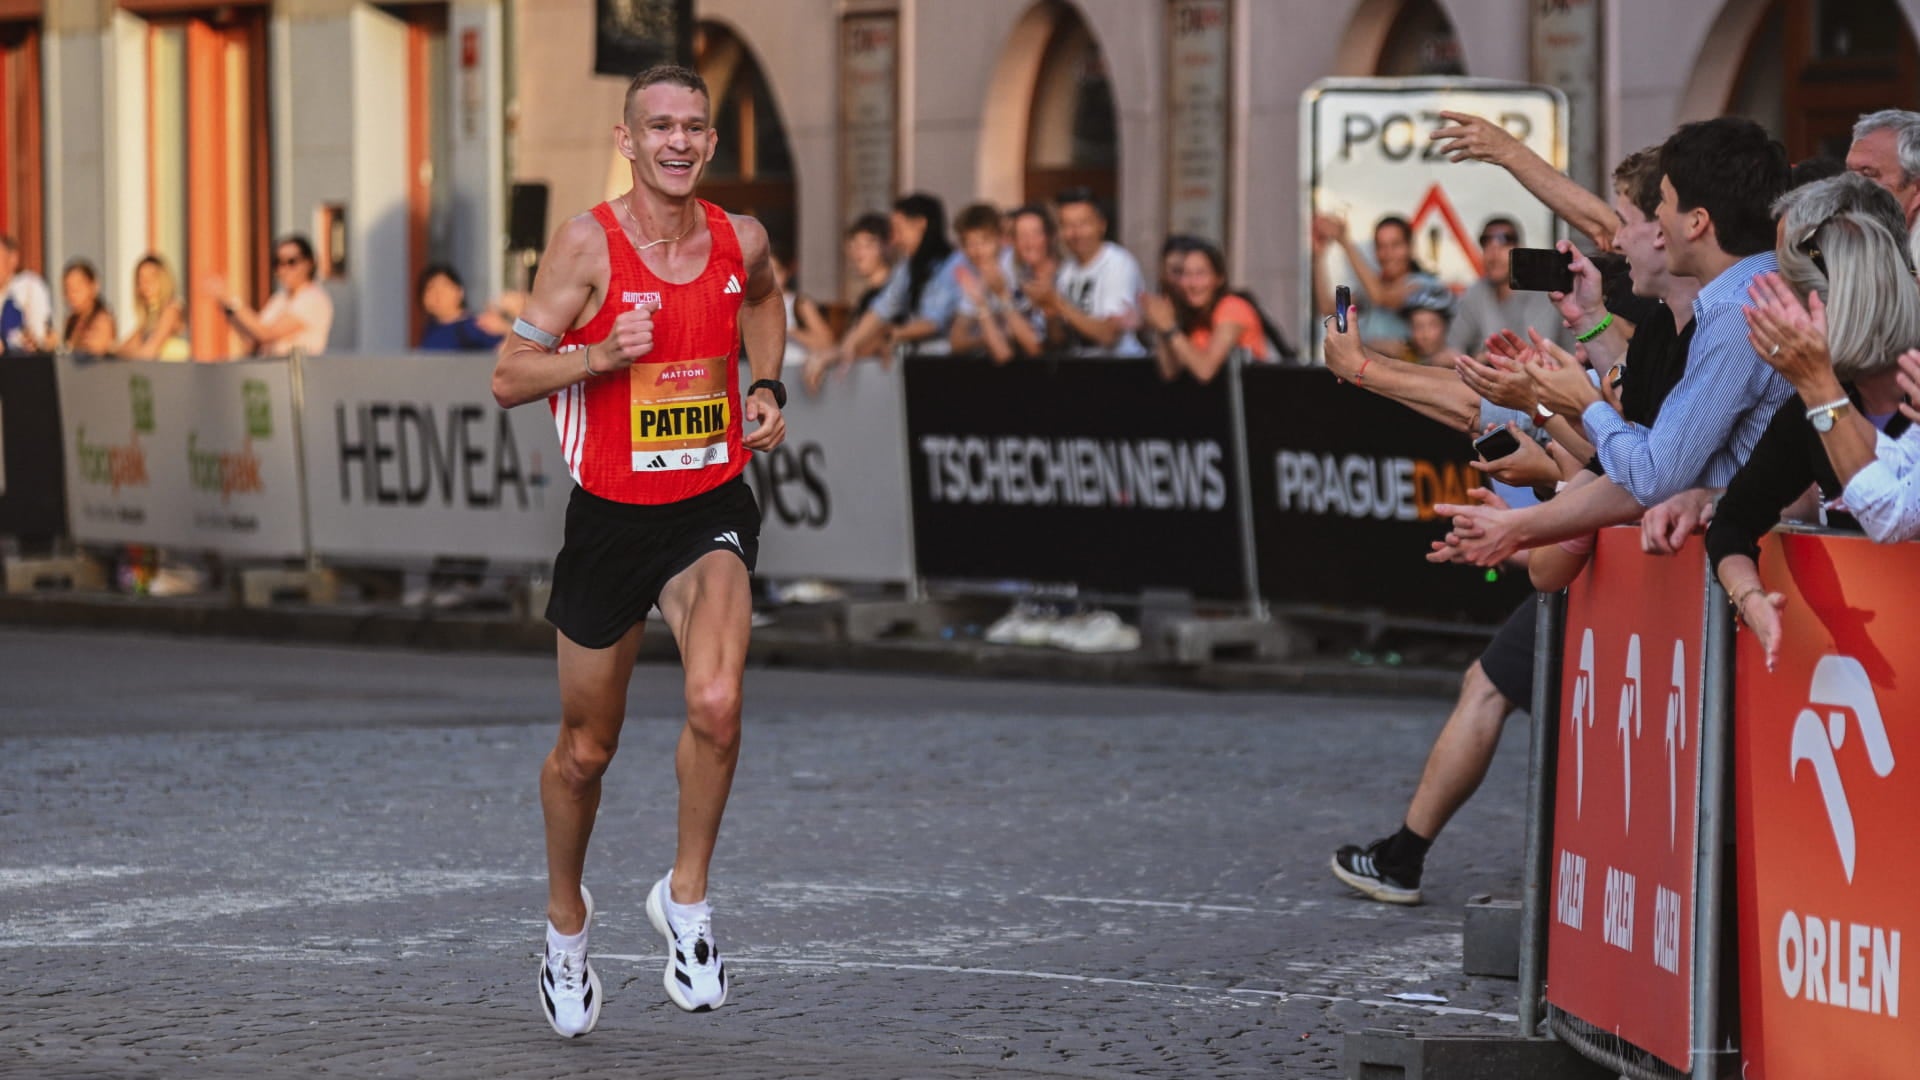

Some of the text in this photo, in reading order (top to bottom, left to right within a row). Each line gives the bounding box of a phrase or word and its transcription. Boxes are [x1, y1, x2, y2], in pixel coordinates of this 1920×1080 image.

[1342, 110, 1532, 162] POZR
[661, 368, 705, 380] MATTONI
[640, 403, 724, 437] PATRIK
[1557, 849, 1586, 931] ORLEN
[1604, 865, 1636, 953] ORLEN
[1653, 883, 1681, 976] ORLEN
[1778, 910, 1901, 1018] ORLEN
